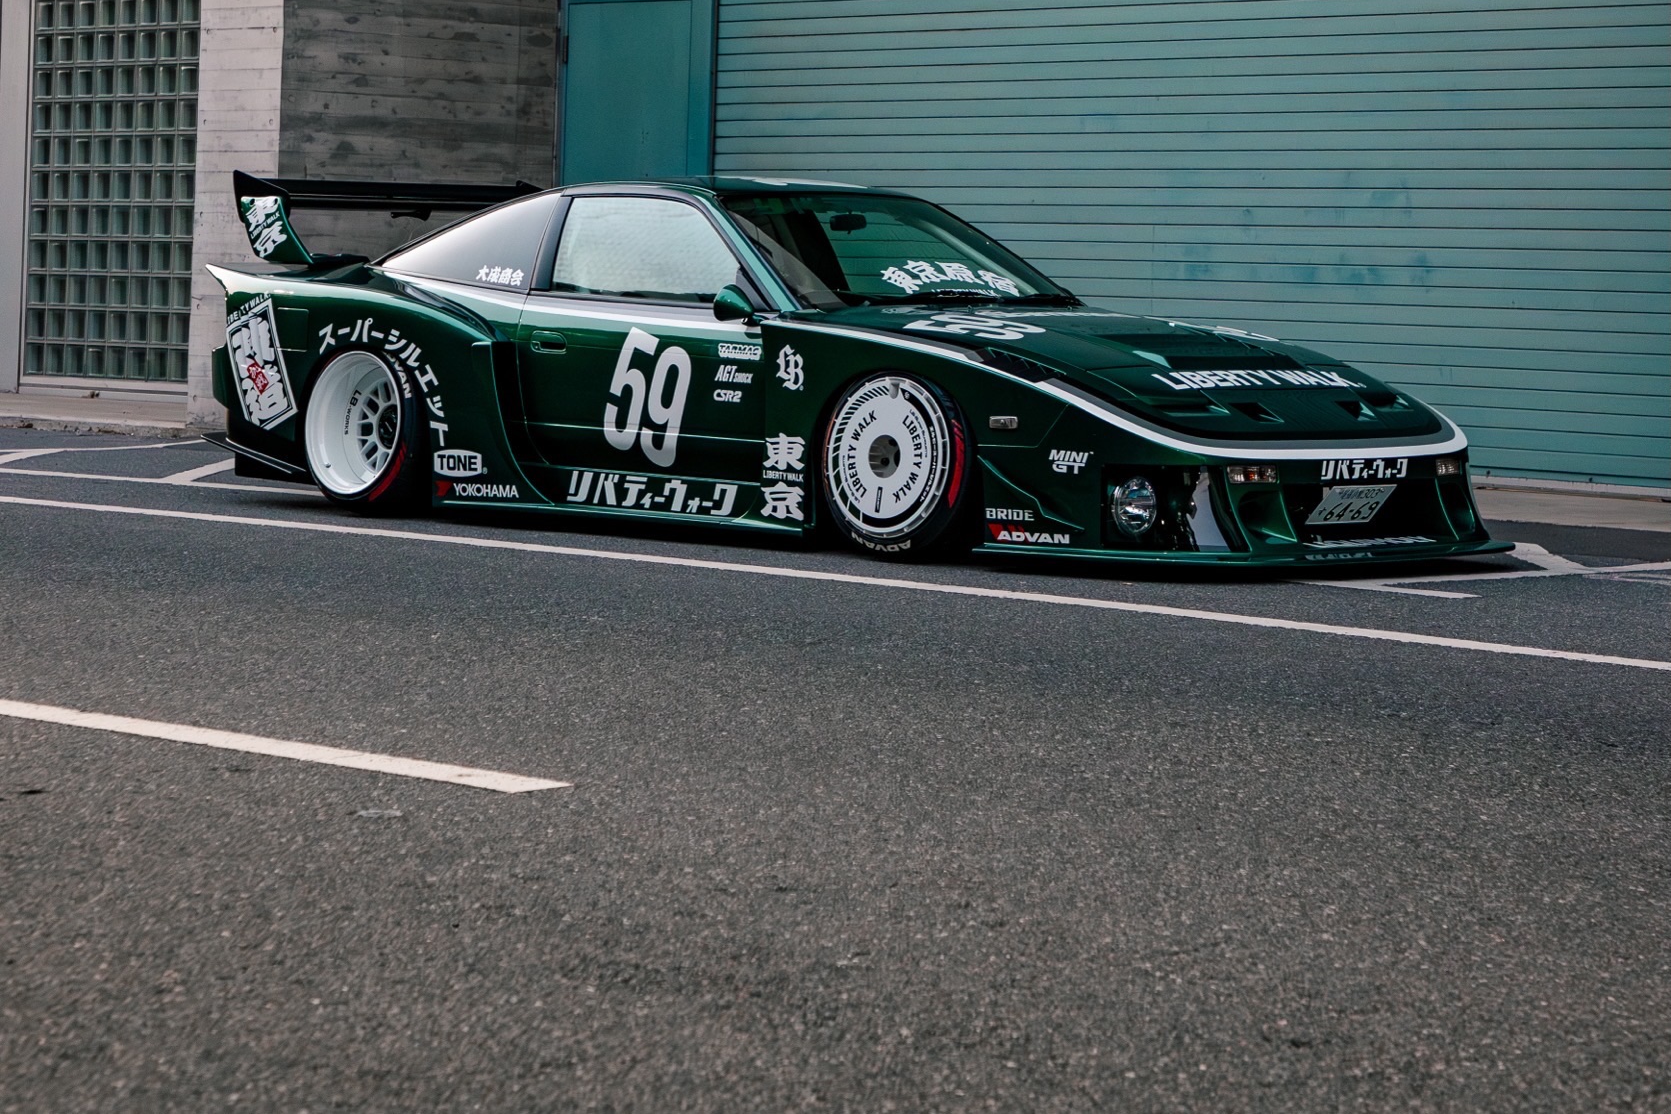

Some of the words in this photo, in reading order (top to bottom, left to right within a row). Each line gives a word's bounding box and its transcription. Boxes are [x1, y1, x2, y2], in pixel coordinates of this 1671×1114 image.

[319, 318, 448, 447] スーパーシルエット
[714, 364, 738, 382] AGT
[1151, 370, 1282, 391] LIBERTY
[603, 326, 692, 468] 59
[713, 389, 743, 403] CSR2
[851, 409, 877, 442] WALK
[902, 414, 923, 470] LIBERTY
[437, 454, 478, 472] TONE
[1048, 449, 1089, 463] MINI
[847, 444, 867, 498] LIBERTY
[1052, 461, 1086, 475] GT
[1321, 458, 1408, 480] リバティーウォーク
[453, 483, 519, 498] YOKOHAMA
[566, 470, 739, 516] リバティーウォーク
[893, 472, 919, 503] WALK
[985, 508, 1035, 522] BRIDE
[997, 531, 1071, 545] ADVAN
